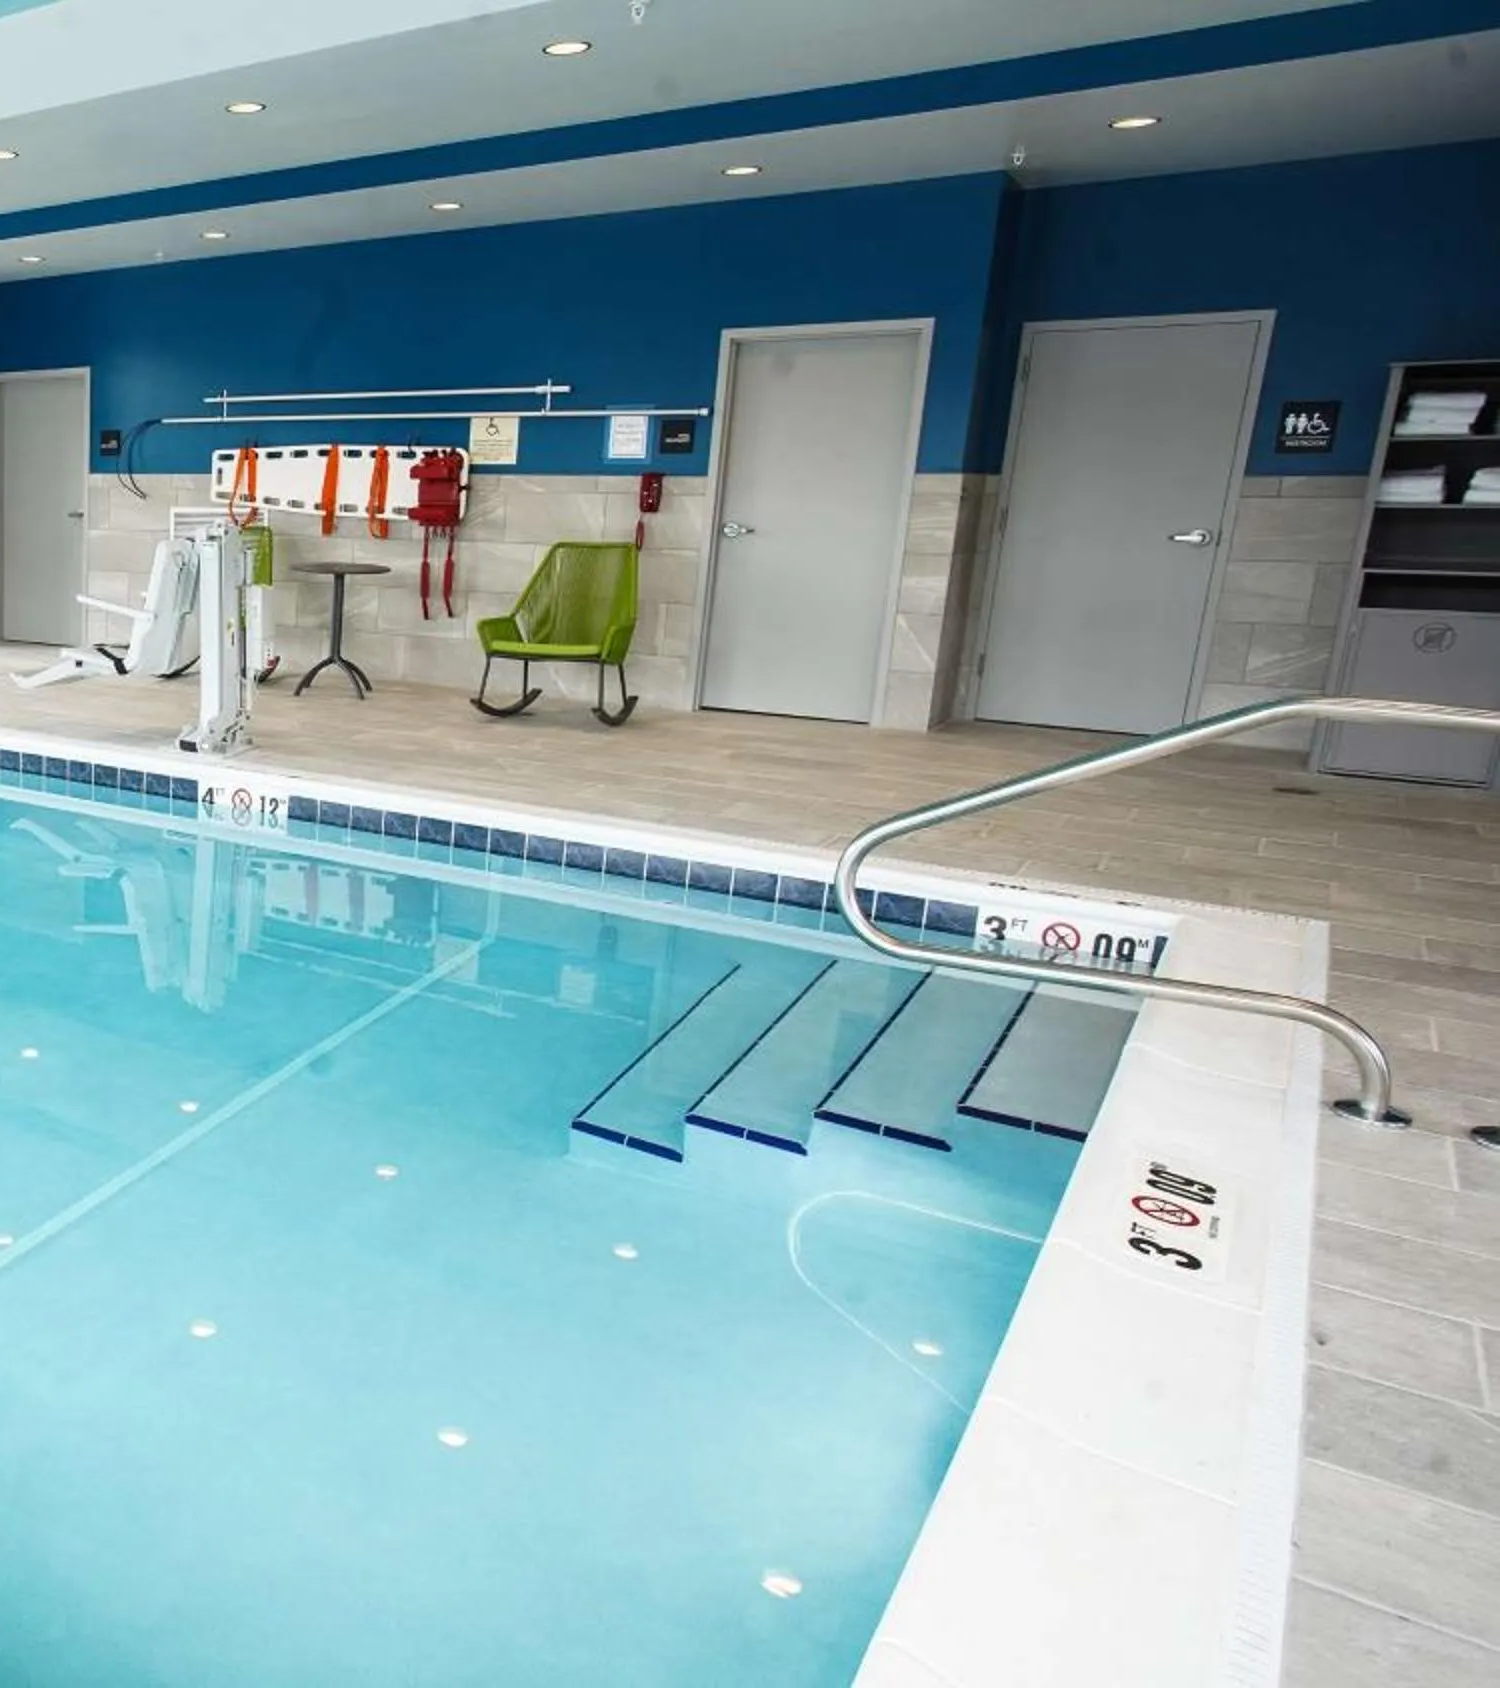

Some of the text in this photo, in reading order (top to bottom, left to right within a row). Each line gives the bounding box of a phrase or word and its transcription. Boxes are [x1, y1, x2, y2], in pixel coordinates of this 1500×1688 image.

[202, 787, 215, 805] 4
[984, 916, 1007, 940] 3
[1011, 918, 1028, 931] FT
[1138, 939, 1149, 949] M
[1128, 1237, 1203, 1270] 3
